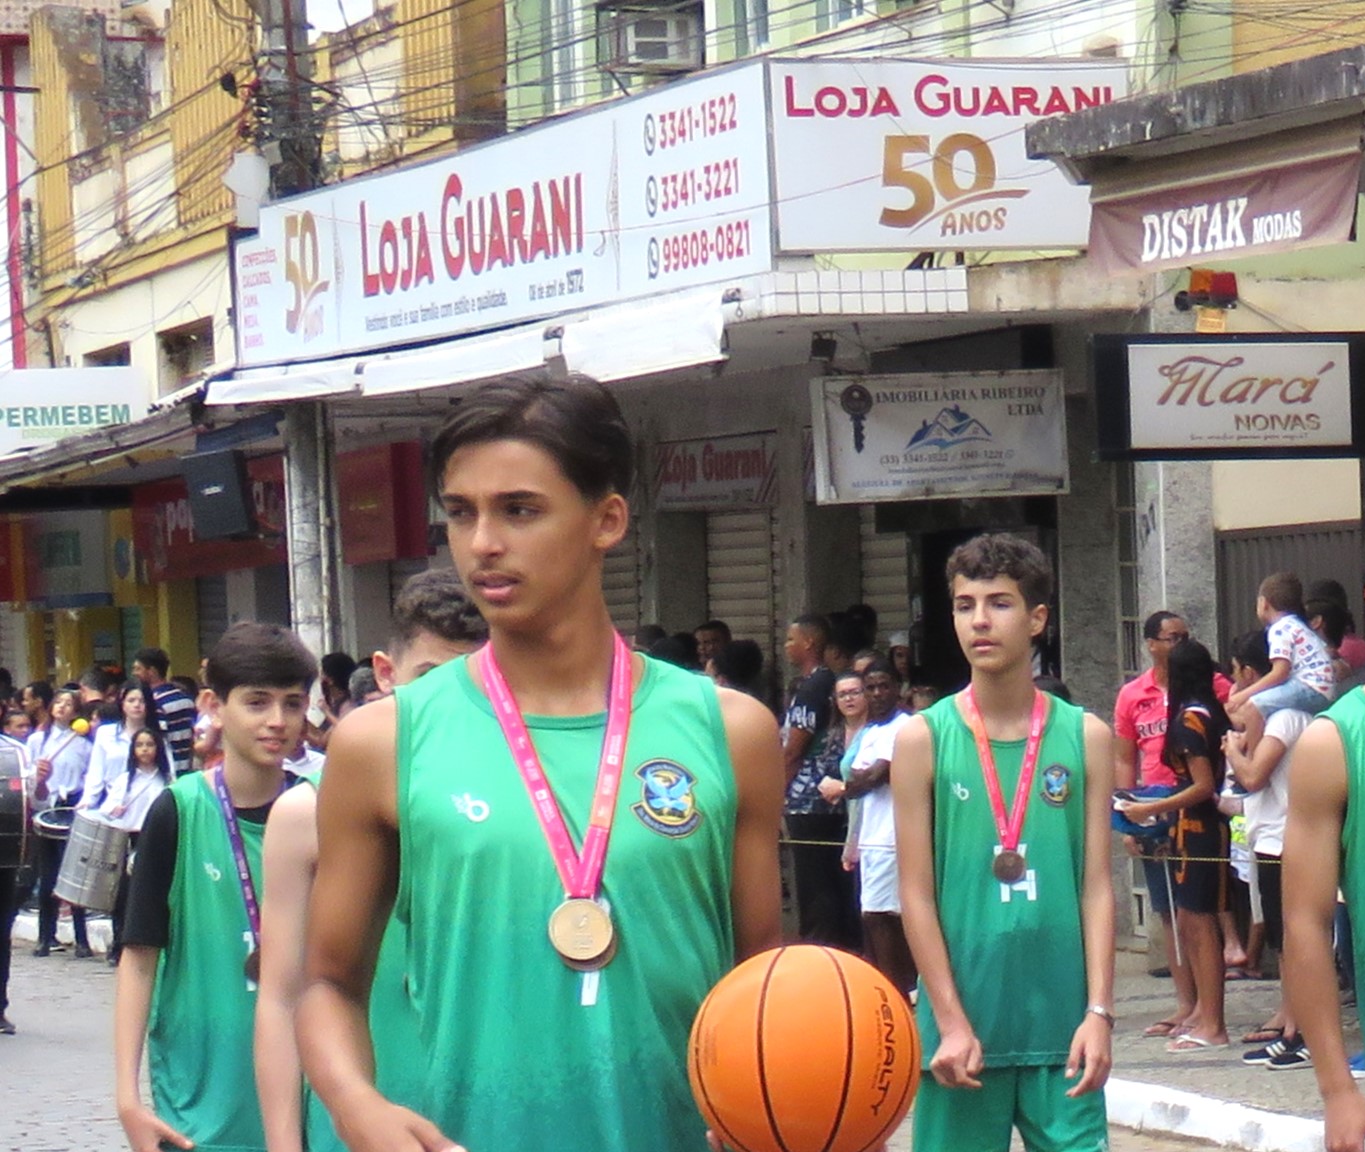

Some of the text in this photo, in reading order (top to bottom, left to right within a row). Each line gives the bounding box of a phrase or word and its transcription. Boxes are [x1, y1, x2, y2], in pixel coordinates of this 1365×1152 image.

[659, 92, 737, 149] 3341-1522
[784, 75, 901, 118] LOJA
[661, 157, 739, 212] 3341-3221
[879, 132, 997, 229] 50
[360, 173, 583, 298] LOJA GUARANI
[663, 219, 751, 273] 99808-0821
[940, 206, 1007, 237] ANOS
[1141, 197, 1301, 263] DISTAK MODAS
[981, 385, 1046, 400] RIBEIRO
[1007, 404, 1044, 417] LTDA
[1234, 413, 1321, 431] NOIVAS
[870, 986, 896, 1116] PENALTY
